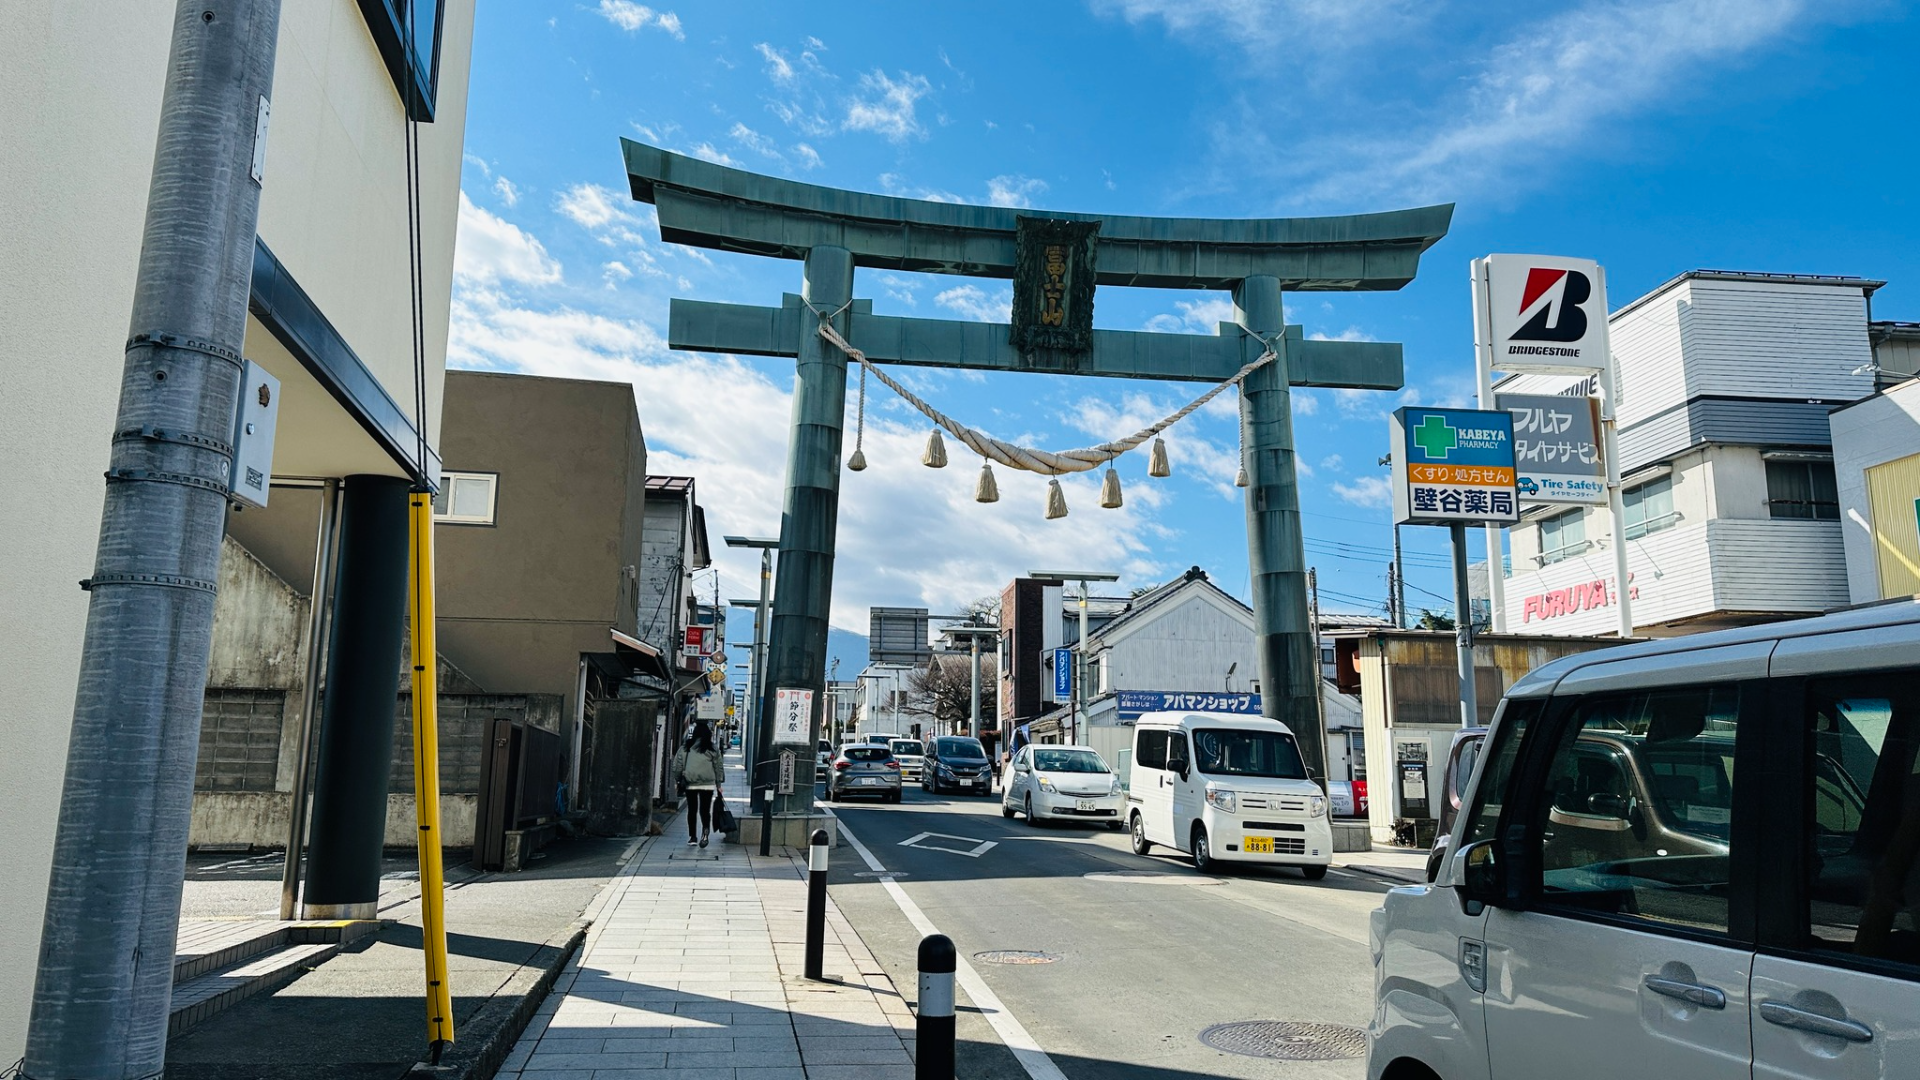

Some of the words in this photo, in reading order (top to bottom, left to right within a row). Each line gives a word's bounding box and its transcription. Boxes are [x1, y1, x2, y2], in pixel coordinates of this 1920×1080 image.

[1508, 345, 1581, 358] BRIDGESTONE
[1508, 407, 1573, 434] フルヤ
[1458, 428, 1506, 441] KABEYA
[1459, 440, 1499, 449] PHARMACY
[1515, 439, 1603, 465] タイヤサービス
[1413, 466, 1510, 483] くすり・処方せん
[1541, 478, 1563, 489] Tire
[1566, 480, 1604, 493] Safety
[1414, 487, 1513, 515] 壁谷薬局
[1523, 579, 1608, 624] FURUYA
[1163, 694, 1251, 711] アパマンショップ
